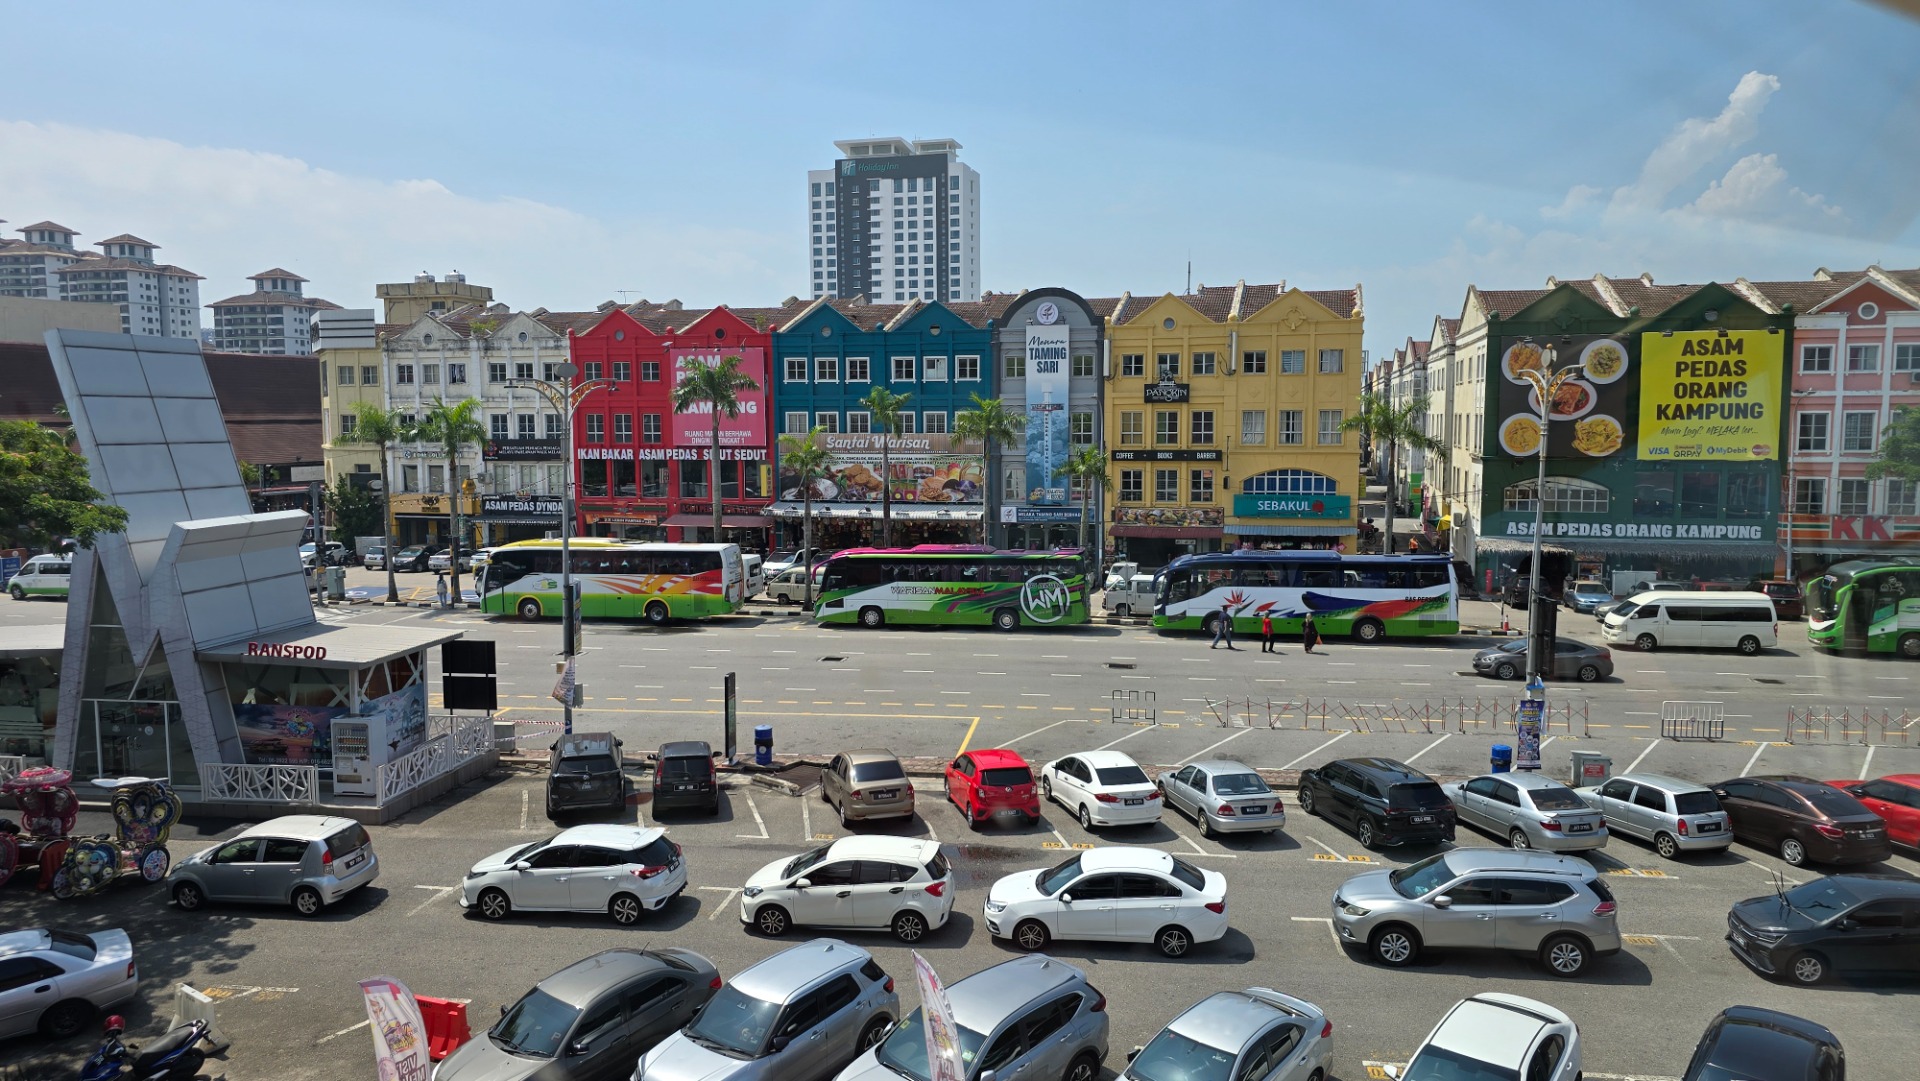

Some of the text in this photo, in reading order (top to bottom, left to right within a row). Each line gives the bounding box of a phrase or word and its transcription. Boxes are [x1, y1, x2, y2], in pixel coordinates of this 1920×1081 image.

[1028, 336, 1066, 346] Menara
[1681, 338, 1744, 356] ASAM
[1029, 347, 1066, 360] TAMING
[1037, 360, 1058, 373] SARI
[1675, 360, 1747, 377] PEDAS
[1674, 381, 1747, 399] ORANG
[1657, 402, 1764, 421] KAMPUNG
[1706, 426, 1740, 437] MELAKA
[826, 436, 931, 449] Santai Warisan
[578, 448, 600, 459] IKAN
[601, 448, 633, 460] BAKAR
[639, 449, 665, 460] ASAM
[666, 449, 697, 460] PEDAS
[734, 449, 767, 460] SEDUT
[1648, 447, 1670, 455] VISA
[1673, 450, 1702, 458] QRPAY
[1715, 447, 1747, 456] MyDebit
[485, 501, 563, 511] ASAM PEDAS DYNDA
[1257, 500, 1310, 511] SEBAKUL
[1506, 522, 1762, 540] ASAM PEDAS ORANG KAMPUNG
[1831, 515, 1892, 540] KK
[248, 641, 327, 660] RANSPOD
